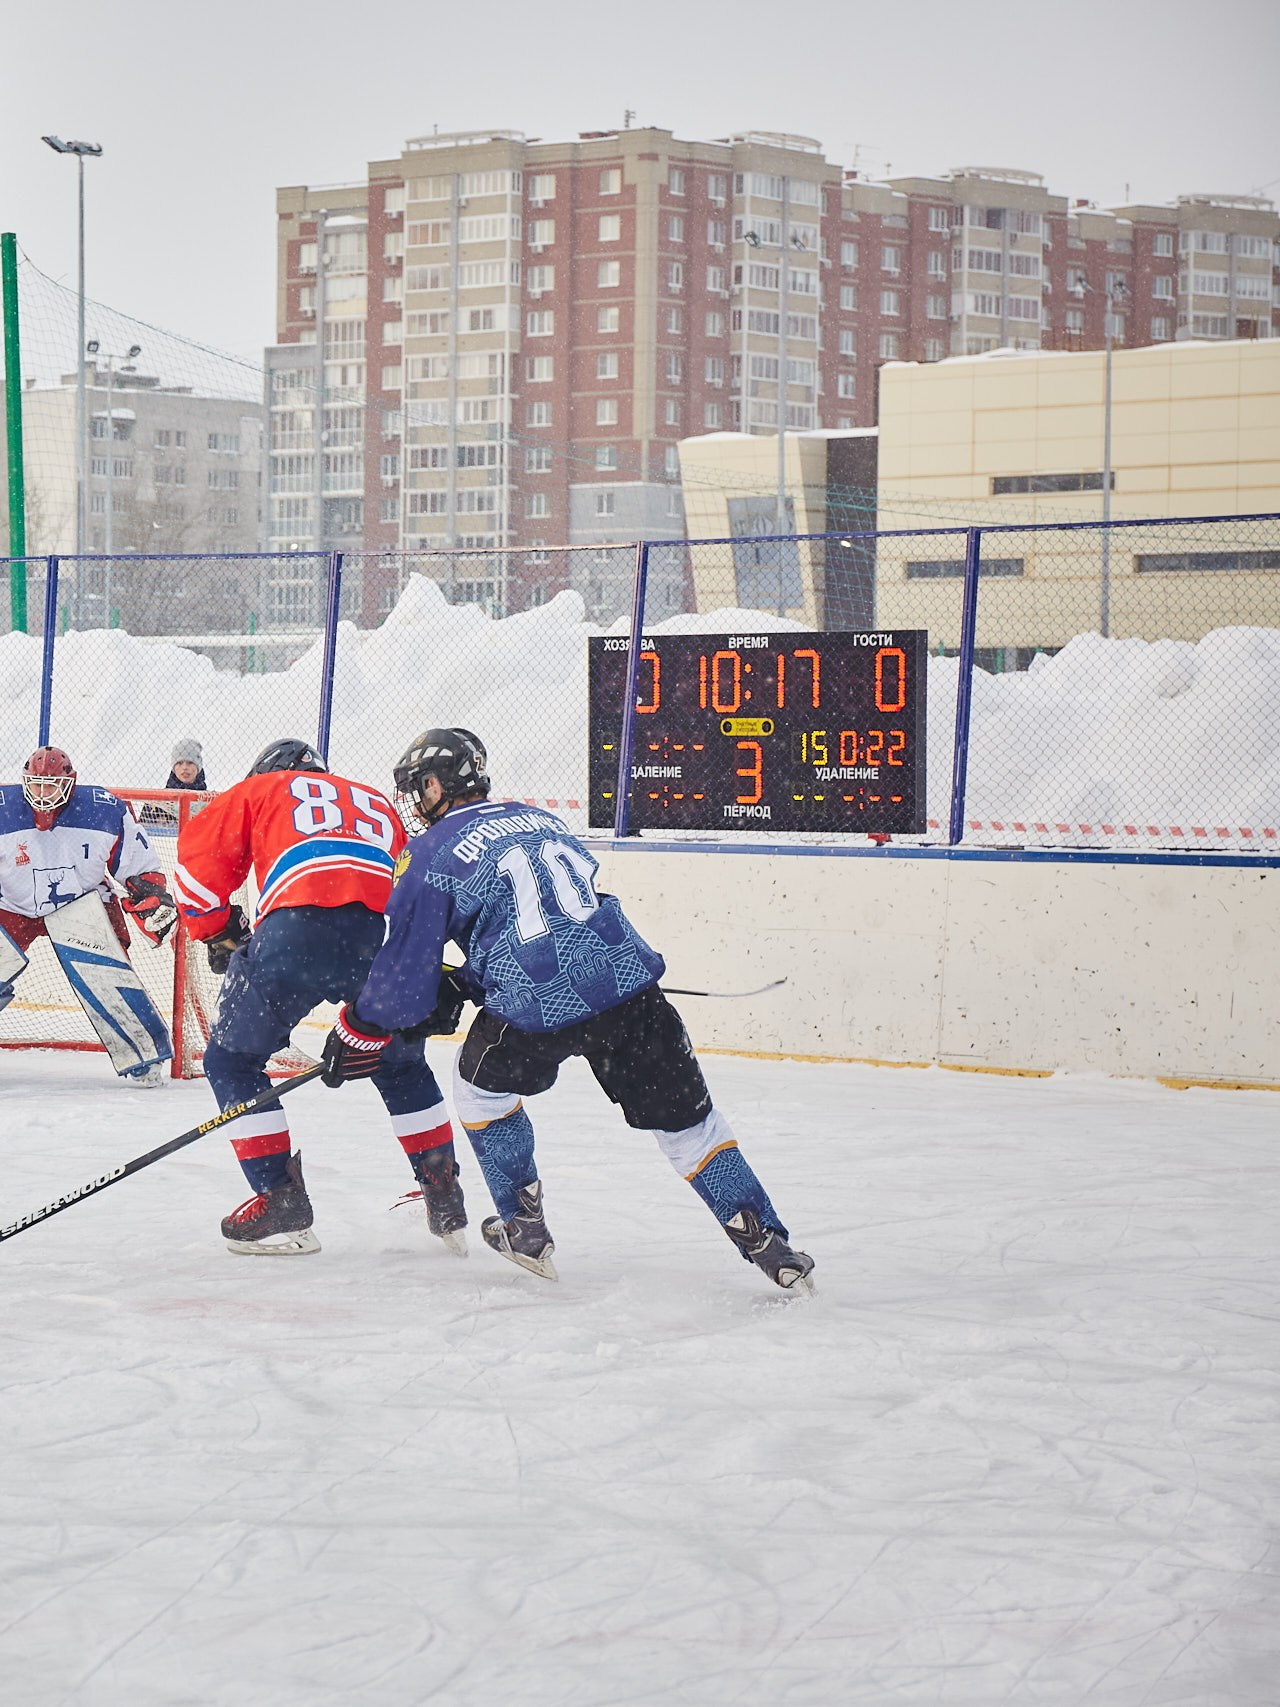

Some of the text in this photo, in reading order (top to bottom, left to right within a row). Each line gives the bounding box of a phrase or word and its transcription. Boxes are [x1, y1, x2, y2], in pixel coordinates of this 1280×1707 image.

[603, 638, 656, 651] ХОЗЯВА
[728, 636, 769, 649] ВРЕМЯ
[853, 633, 893, 647] ГОСТИ
[699, 649, 820, 713] 10:17
[875, 647, 906, 712] 0
[801, 730, 906, 766] 15 0:22
[630, 765, 683, 780] ДАЛЕНИЕ
[735, 741, 763, 804] 3
[815, 767, 880, 781] УДАЛЕНИЕ
[289, 775, 395, 852] 85
[723, 804, 772, 820] ПЕРИОД
[81, 843, 90, 860] 1
[135, 831, 149, 850] 1
[496, 839, 601, 944] 10
[334, 1018, 385, 1052] ARRIOR
[198, 1102, 246, 1134] REKKER
